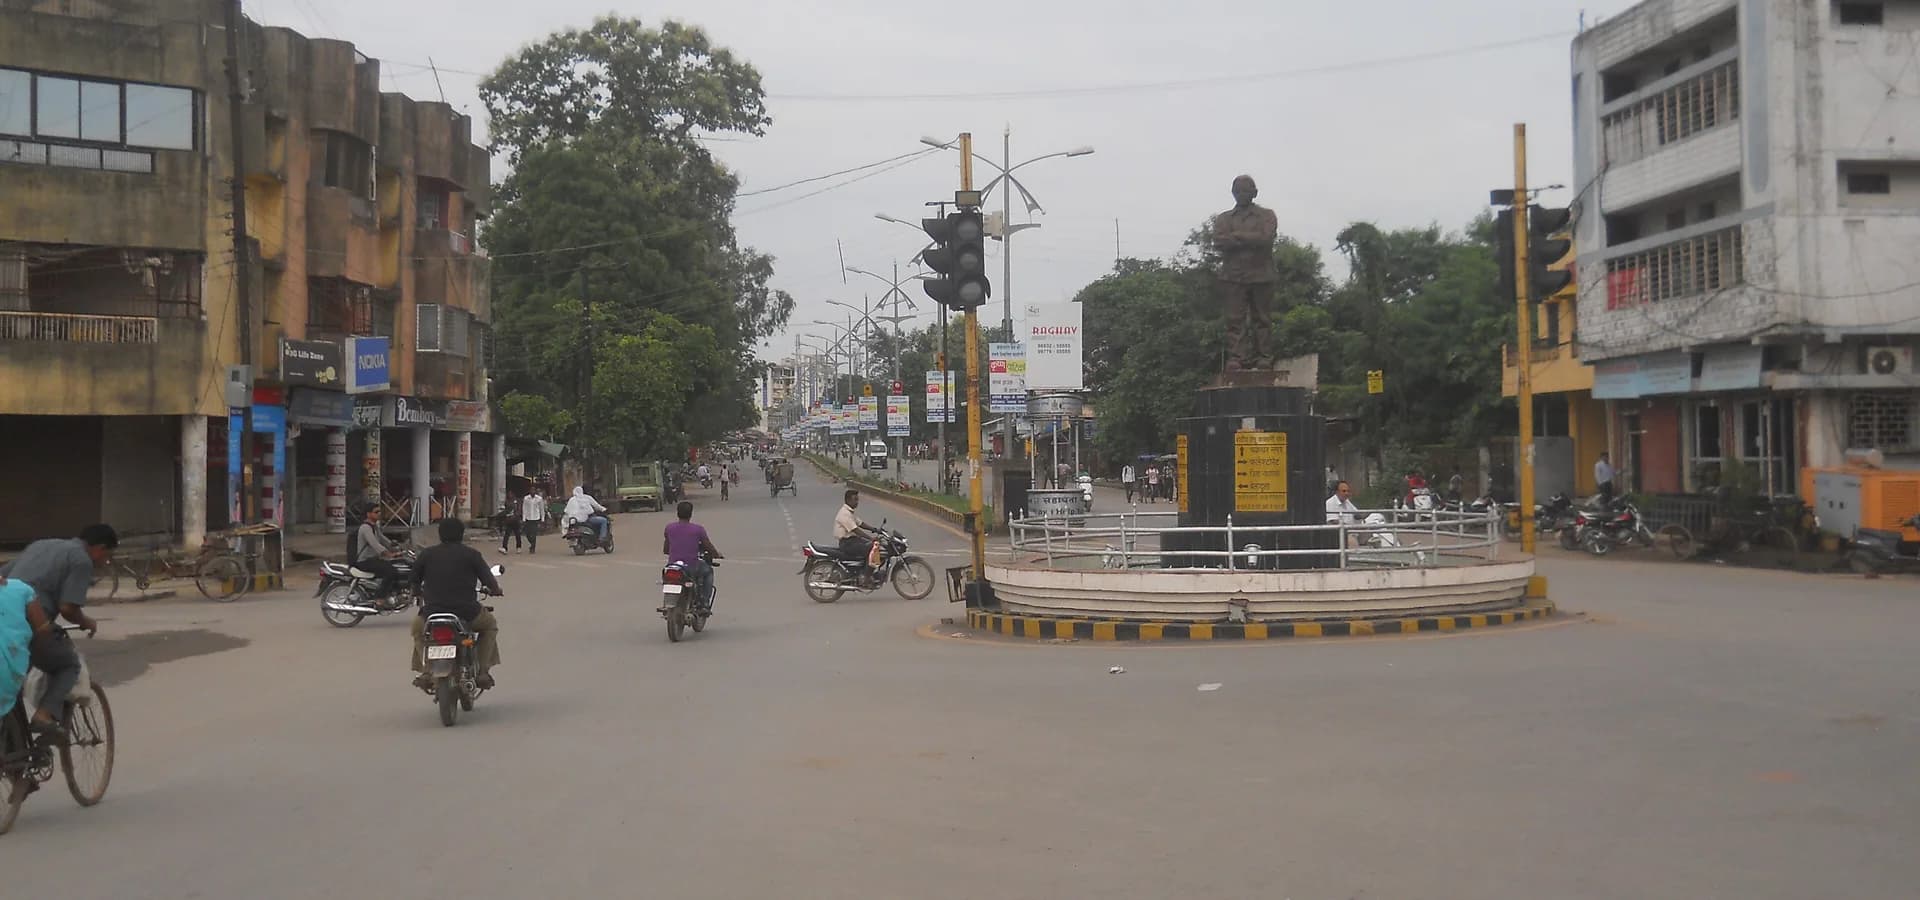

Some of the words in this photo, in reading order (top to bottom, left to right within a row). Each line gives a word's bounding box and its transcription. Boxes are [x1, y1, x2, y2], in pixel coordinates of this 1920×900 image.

[1032, 326, 1077, 335] RAGHAV
[358, 354, 386, 370] NOKIA
[397, 398, 434, 426] Bombay
